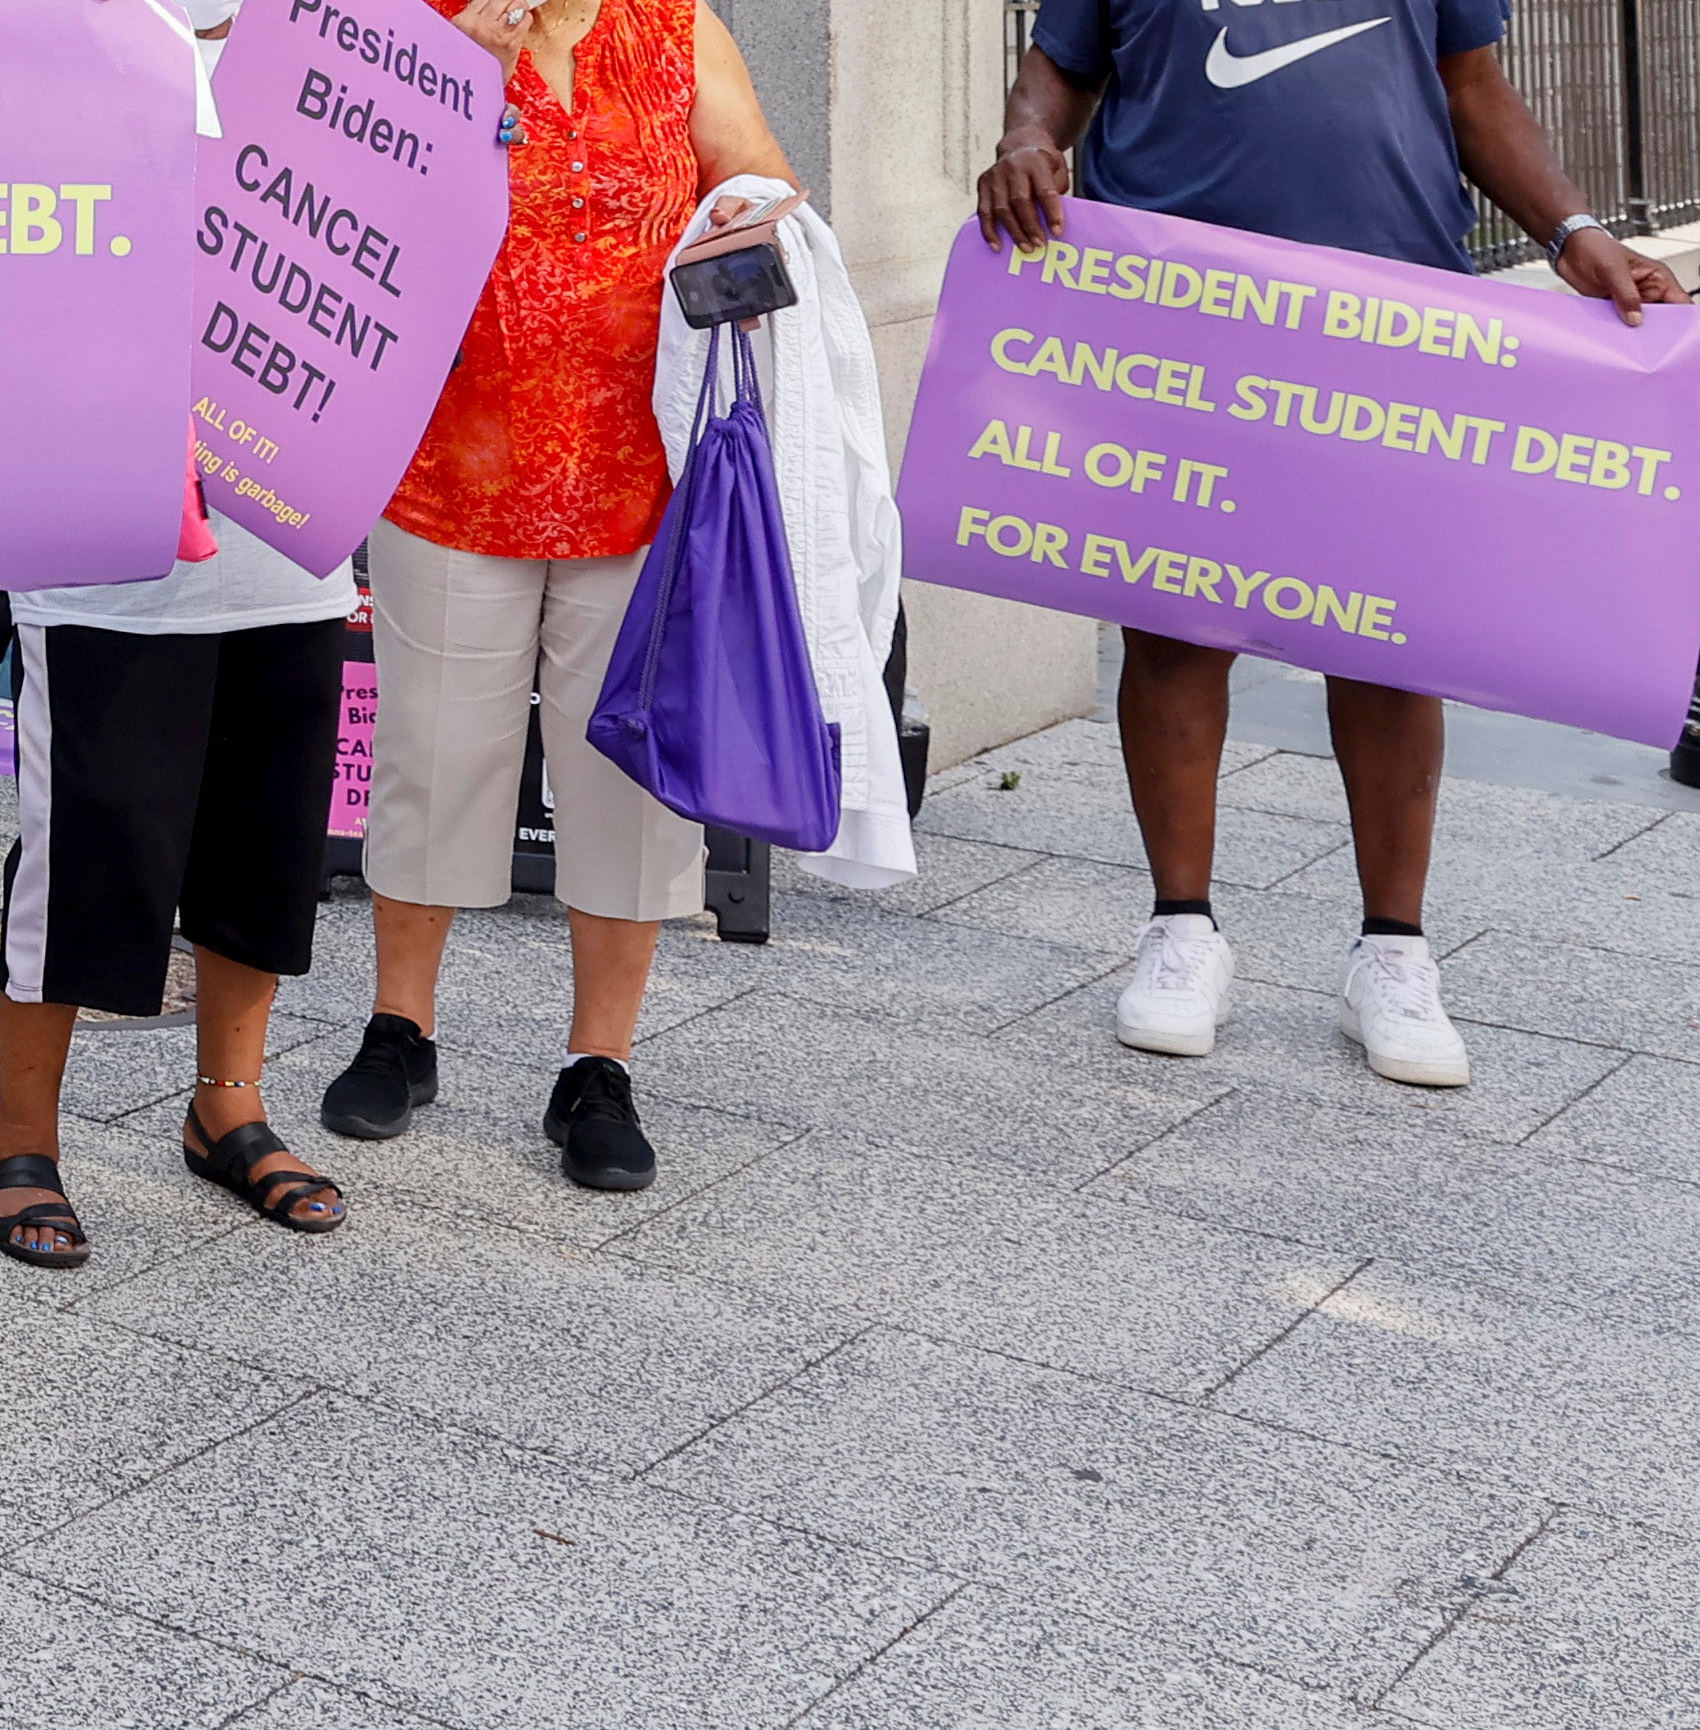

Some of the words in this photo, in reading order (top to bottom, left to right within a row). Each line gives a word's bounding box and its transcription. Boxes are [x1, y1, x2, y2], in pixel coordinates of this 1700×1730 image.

[296, 66, 434, 176] Biden:
[235, 143, 403, 298] CANCEL
[196, 205, 399, 372] STUDENT
[1008, 238, 1317, 330] PRESIDENT
[1323, 290, 1521, 369] BIDEN:
[201, 301, 337, 424] DEBT!
[990, 327, 1216, 413] CANCEL
[1228, 374, 1506, 466] STUDENT
[1511, 425, 1681, 501] DEBT.
[192, 396, 224, 431] ALL
[229, 419, 257, 445] OF
[252, 436, 280, 464] IT!
[968, 419, 1072, 479] ALL
[1084, 442, 1167, 494] OF
[1173, 458, 1237, 513] IT.
[220, 460, 240, 482] is
[234, 477, 311, 529] garbage!
[956, 506, 1069, 570] FOR
[1080, 533, 1408, 646] EVERYONE.
